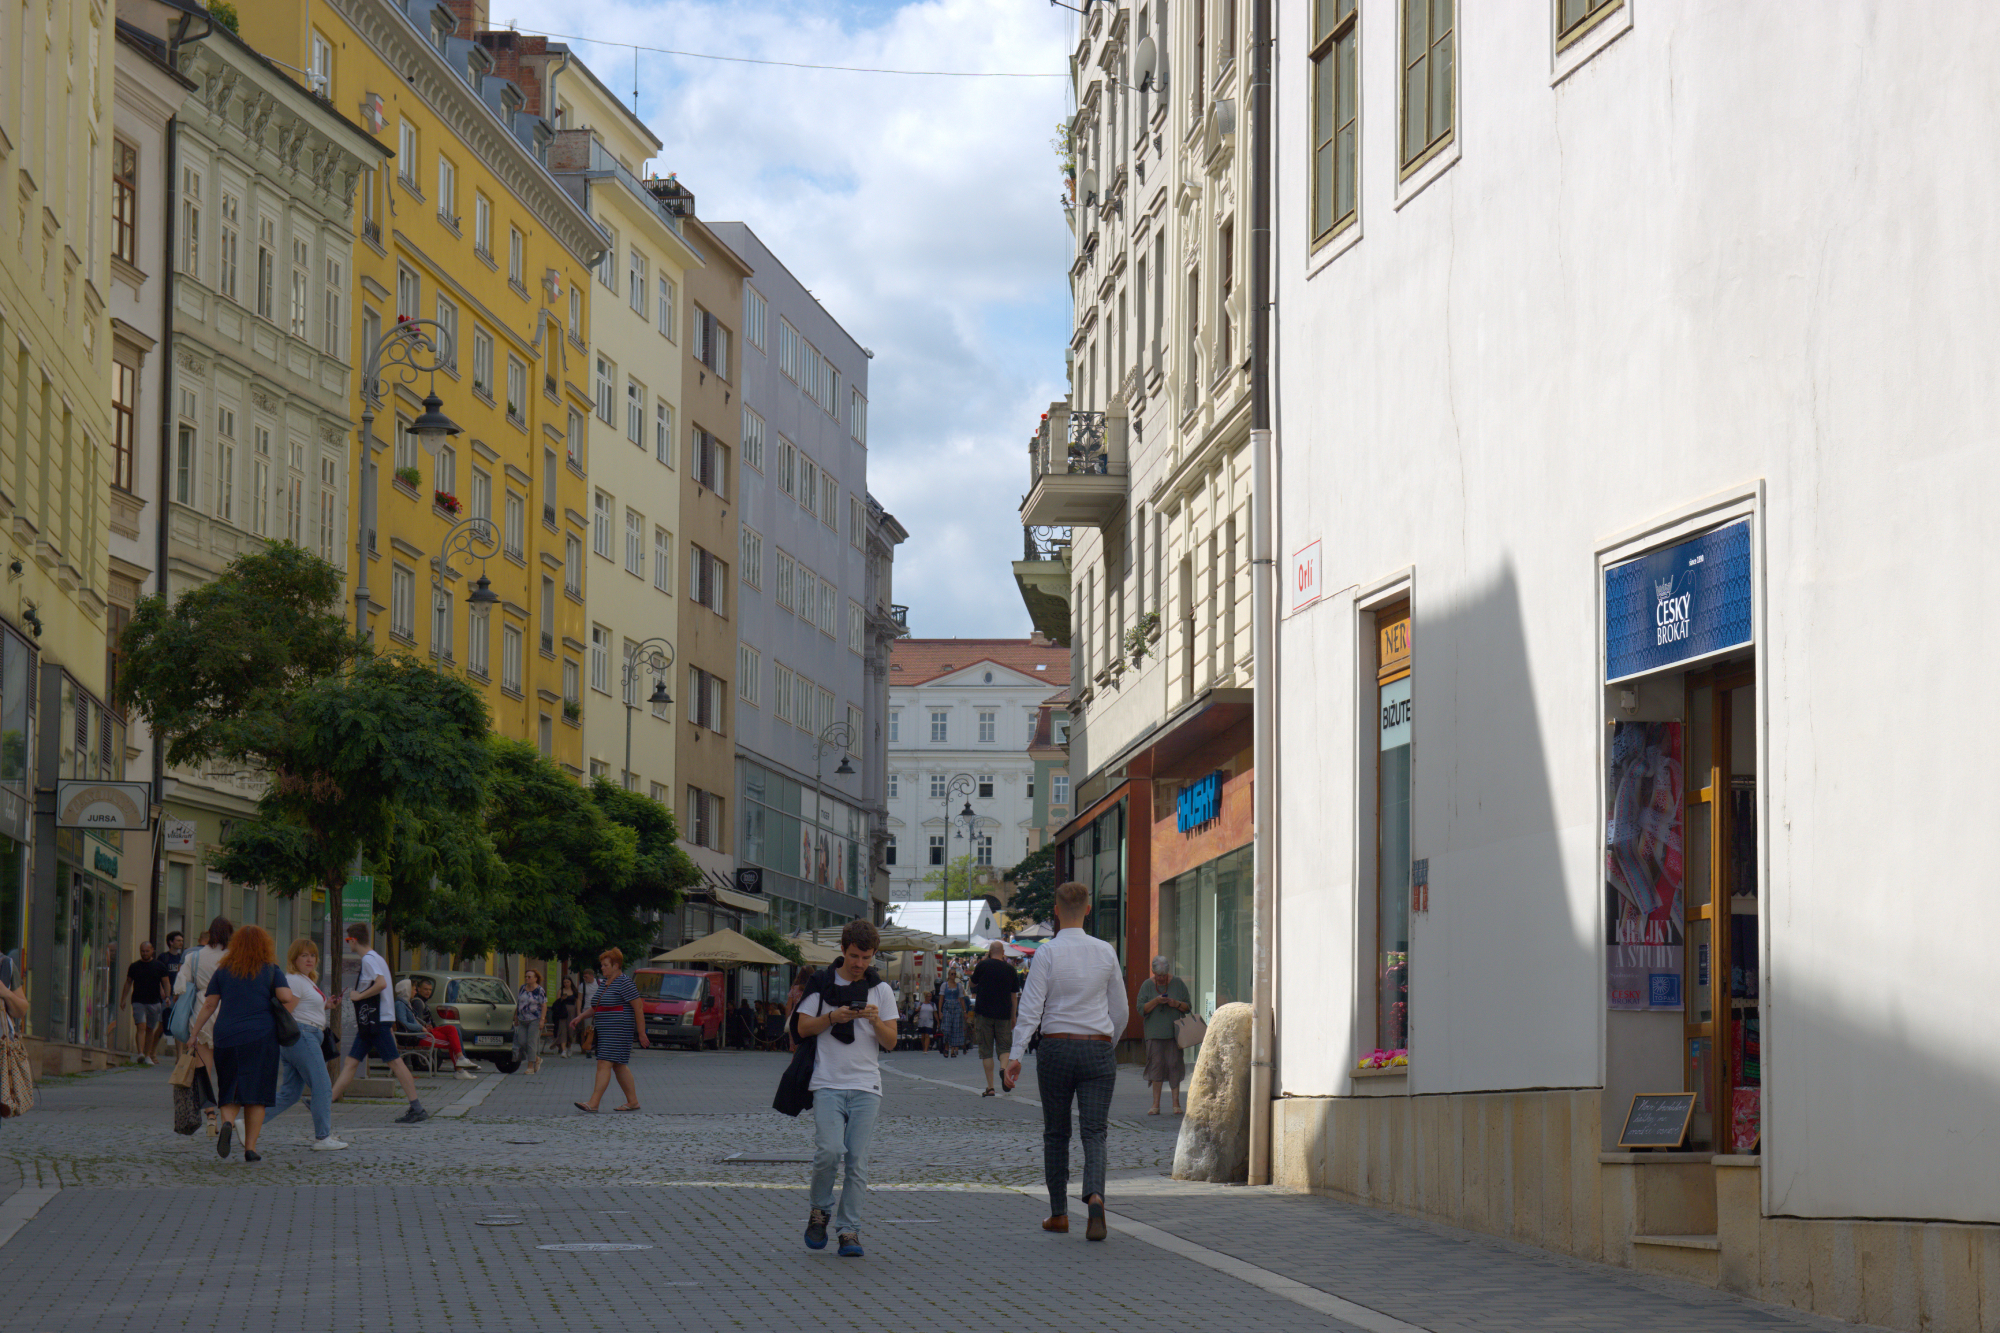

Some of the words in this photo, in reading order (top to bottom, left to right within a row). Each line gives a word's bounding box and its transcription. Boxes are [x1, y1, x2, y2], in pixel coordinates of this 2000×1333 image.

[1298, 558, 1314, 592] Orlí
[1656, 591, 1691, 627] ČESKÝ
[87, 814, 117, 822] JURSA
[820, 809, 830, 821] TIGER
[1615, 919, 1674, 943] KRAJKY
[1615, 945, 1624, 968] A
[1628, 945, 1676, 968] STUHY
